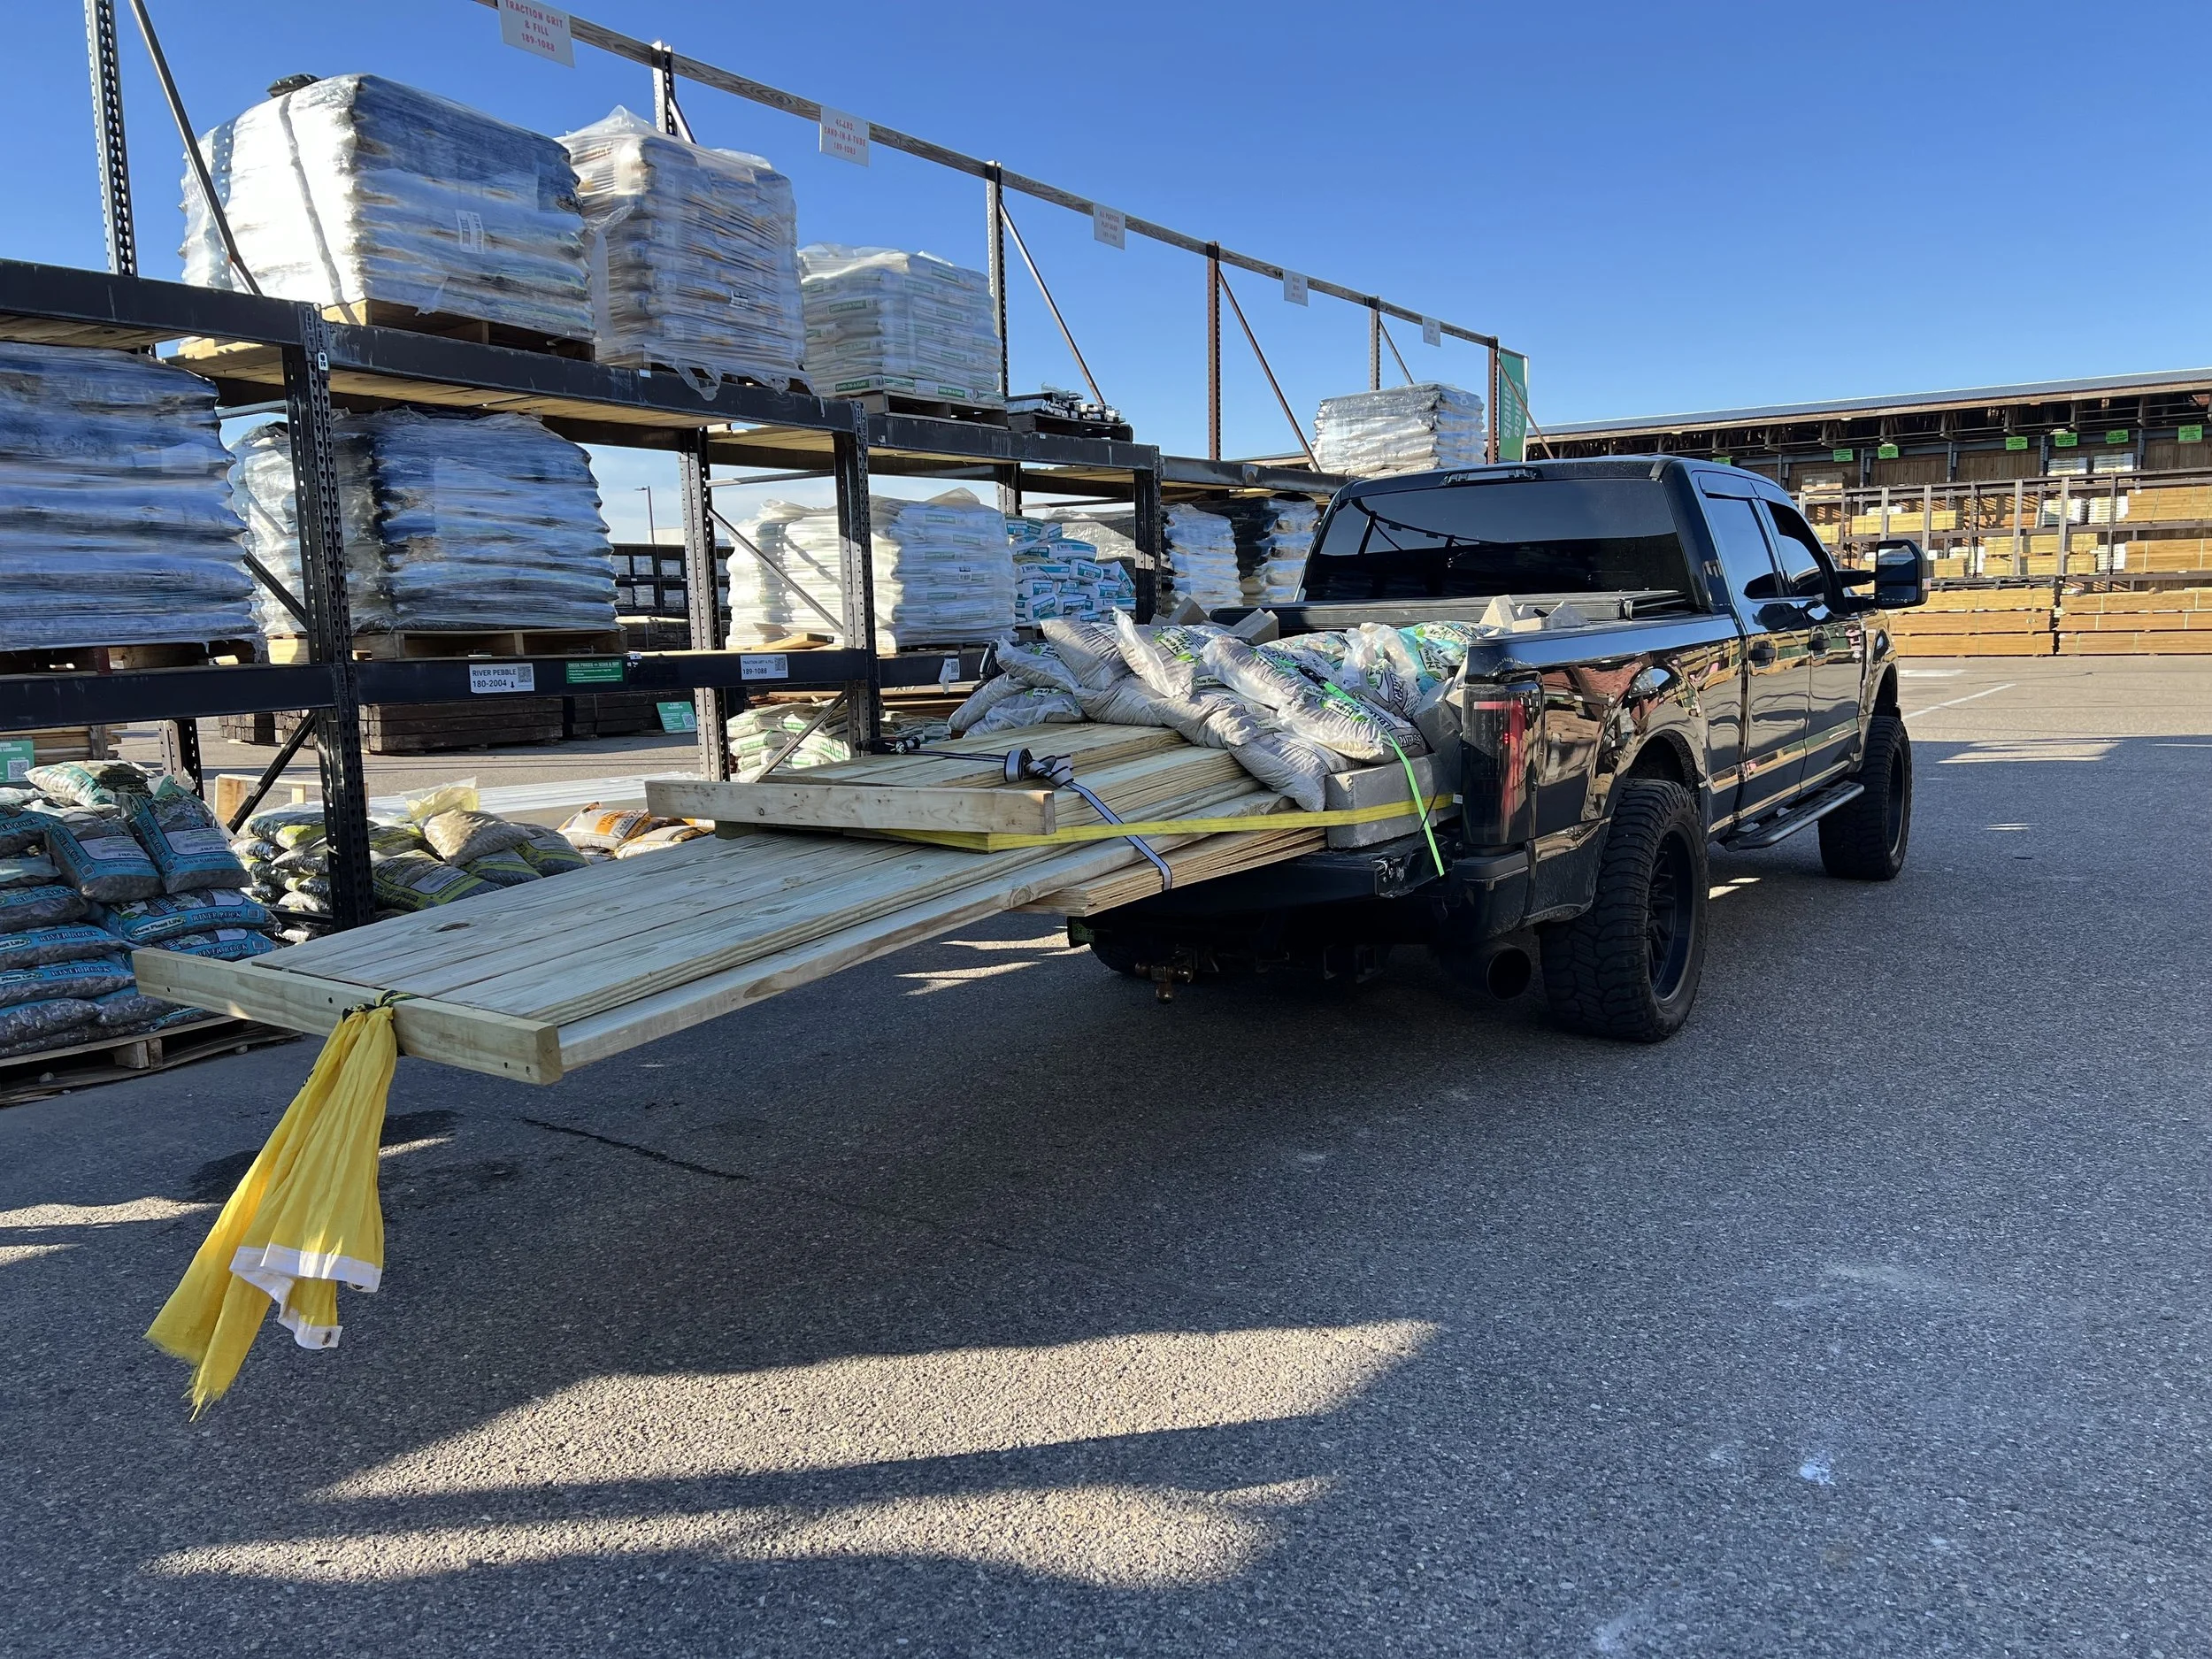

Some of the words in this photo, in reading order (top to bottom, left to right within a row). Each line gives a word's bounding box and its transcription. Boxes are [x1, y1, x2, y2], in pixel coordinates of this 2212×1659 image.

[505, 0, 543, 20] TRACTION
[546, 14, 563, 28] GRIT
[524, 19, 531, 29] &
[533, 22, 549, 36] FILL
[521, 33, 555, 51] 189-1088
[1503, 383, 1512, 439] anels
[1514, 380, 1524, 438] Fnce
[472, 679, 507, 687] 180-2004
[191, 911, 219, 922] RIVER
[219, 910, 242, 920] ROCK
[196, 947, 222, 956] RIVER
[222, 943, 249, 953] ROCK
